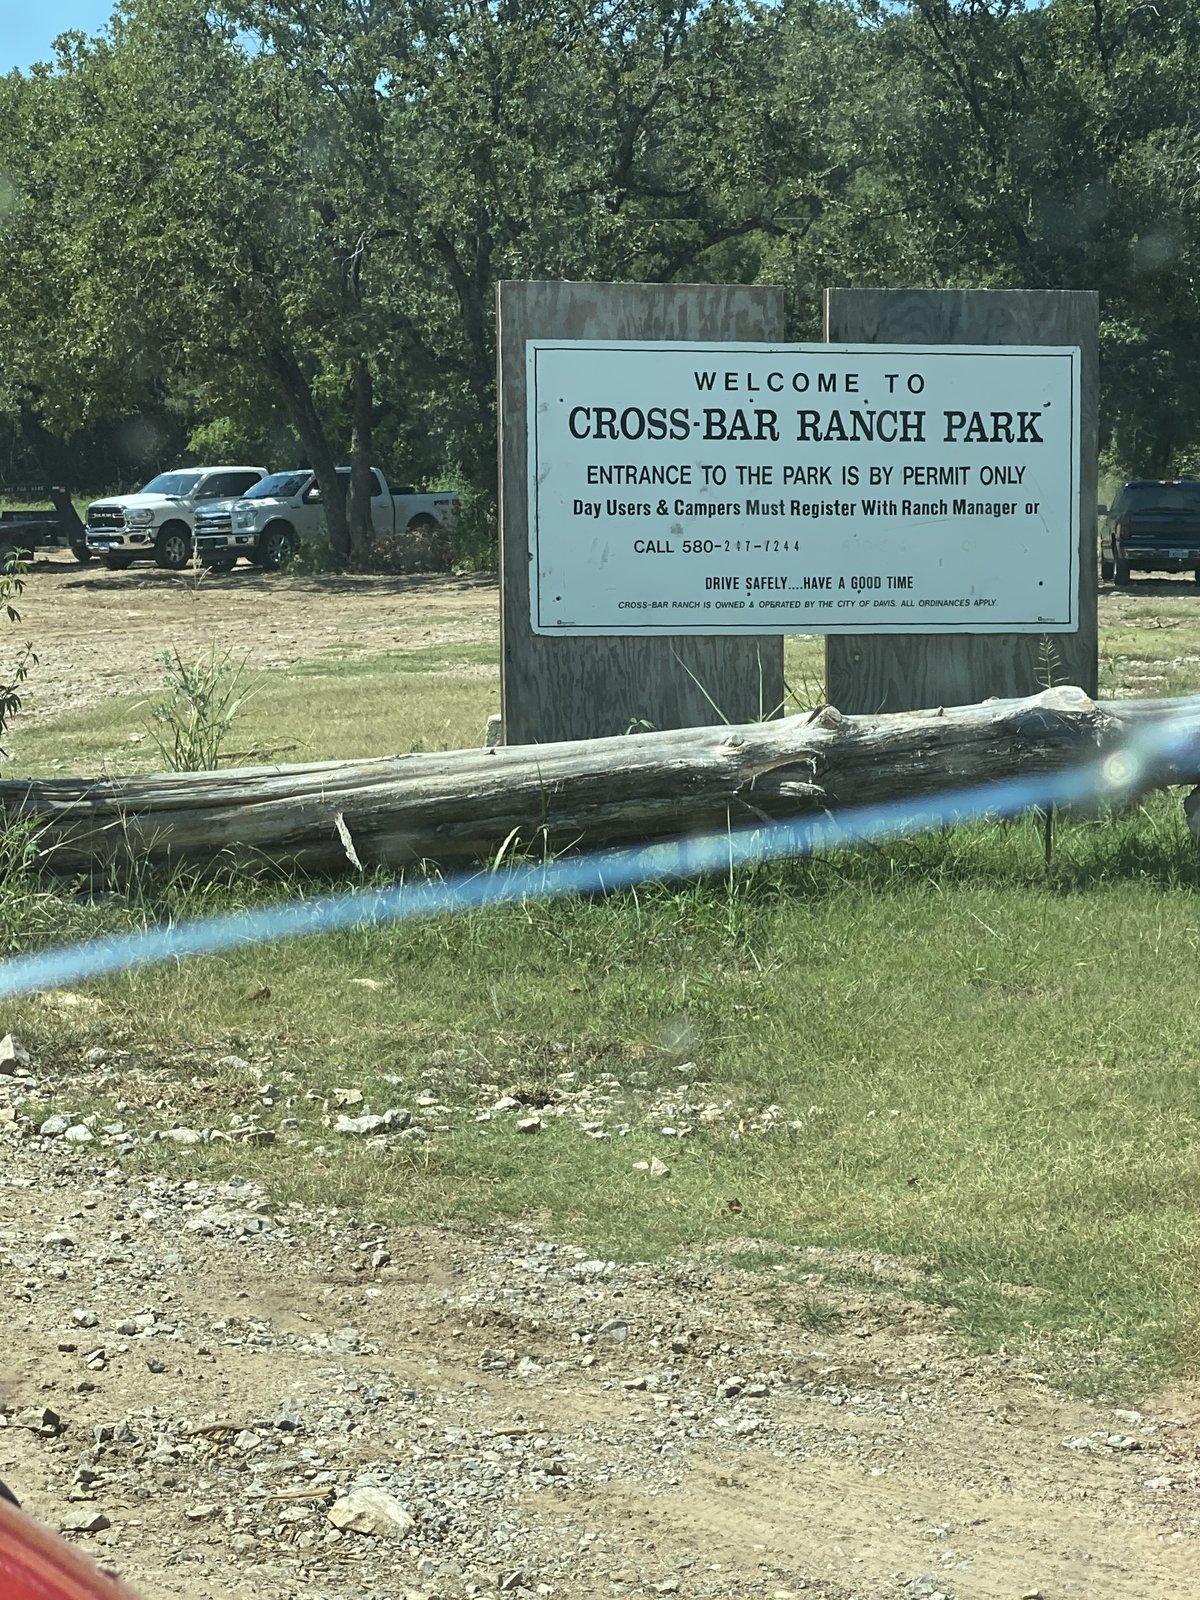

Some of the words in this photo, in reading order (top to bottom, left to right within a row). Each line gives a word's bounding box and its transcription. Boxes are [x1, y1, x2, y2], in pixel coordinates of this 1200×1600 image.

[694, 372, 860, 393] WELCOME
[885, 374, 925, 394] TO
[568, 406, 780, 442] CROSS-BAR
[797, 409, 926, 443] RANCH
[943, 411, 1044, 443] PARK
[587, 465, 692, 485] ENTRANCE
[701, 466, 727, 486] TO
[735, 466, 773, 486] THE
[783, 466, 832, 486] PARK
[842, 466, 859, 486] IS
[870, 466, 893, 486] BY
[903, 466, 971, 487] PERMIT
[980, 466, 1027, 487] ONLY
[573, 499, 602, 520] Day
[607, 499, 651, 517] Users
[656, 499, 669, 516] &
[674, 499, 741, 520] Campers
[746, 499, 786, 516] Must
[791, 499, 857, 519] Register
[861, 499, 898, 516] With
[902, 499, 947, 516] Ranch
[953, 499, 1018, 519] Manager
[1025, 501, 1040, 515] or
[634, 539, 675, 554] CALL
[705, 576, 740, 590] DRIVE
[838, 576, 846, 590] A
[851, 576, 882, 589] GOOD
[887, 576, 914, 589] TIME
[617, 600, 669, 609] CROSS-BAR
[672, 601, 701, 609] RANCH
[703, 601, 712, 609] IS
[715, 601, 746, 609] OWNED
[749, 601, 755, 609] &
[758, 600, 802, 609] OPERATED
[804, 600, 815, 608] BY
[818, 600, 834, 608] THE
[837, 600, 856, 608] CITY
[859, 600, 871, 608] OF
[873, 600, 898, 608] DAVIS.
[901, 600, 915, 608] ALL
[918, 599, 971, 608] ORDINANCES
